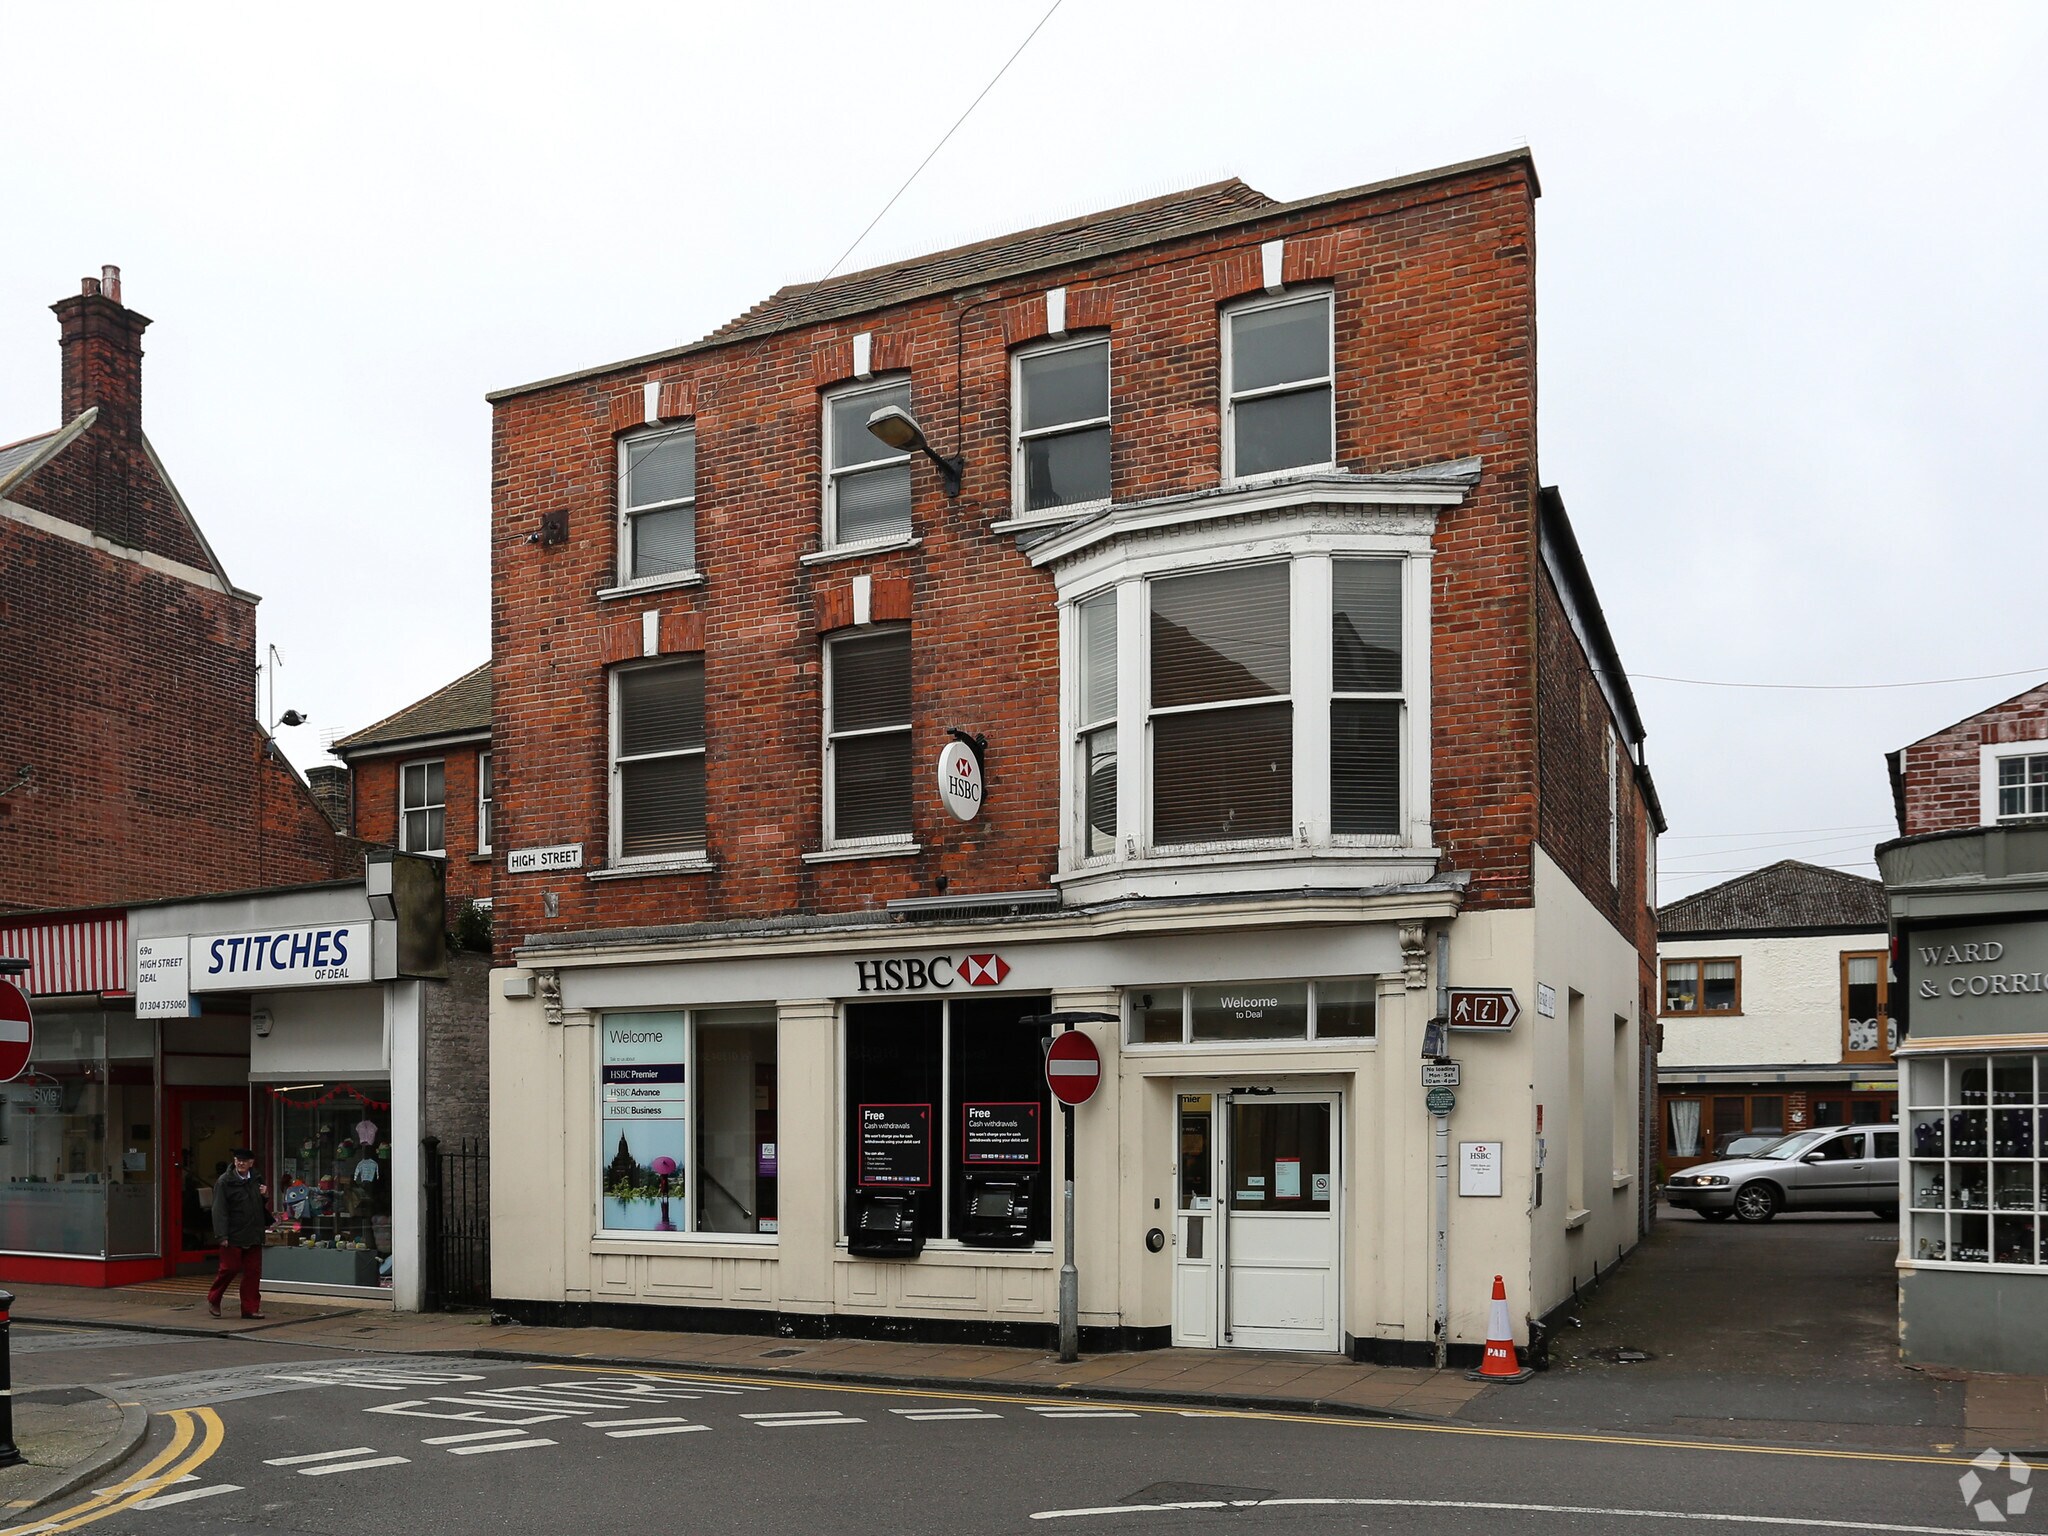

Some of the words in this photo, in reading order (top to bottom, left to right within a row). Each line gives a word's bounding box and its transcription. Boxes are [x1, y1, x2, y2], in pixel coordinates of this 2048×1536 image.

[948, 775, 980, 802] HSBC
[511, 854, 536, 867] HIGH
[541, 850, 578, 865] STREET
[139, 947, 152, 956] 69a
[208, 929, 349, 974] STITCHES
[1918, 941, 2004, 967] WARD
[139, 960, 157, 969] HIGH
[158, 957, 183, 968] STREET
[139, 974, 157, 983] DEAL
[314, 969, 327, 980] OF
[327, 968, 349, 979] DEAL
[854, 956, 955, 992] HSBC
[1919, 979, 1941, 998] &
[139, 1001, 161, 1011] 01304
[161, 1000, 187, 1010] 375060
[1220, 996, 1278, 1008] Welcome
[1236, 1011, 1244, 1019] to
[1245, 1010, 1263, 1019] Deal
[610, 1030, 663, 1043] Welcome
[610, 1070, 631, 1079] HSBC
[631, 1069, 659, 1079] Premier
[610, 1088, 631, 1097] HSBC
[631, 1088, 661, 1097] Advance
[610, 1106, 631, 1115] HSBC
[631, 1106, 662, 1115] Business
[864, 1110, 885, 1120] Free
[969, 1108, 991, 1118] Free
[1470, 1152, 1491, 1160] HSBC
[361, 1373, 772, 1426] ENTRY
